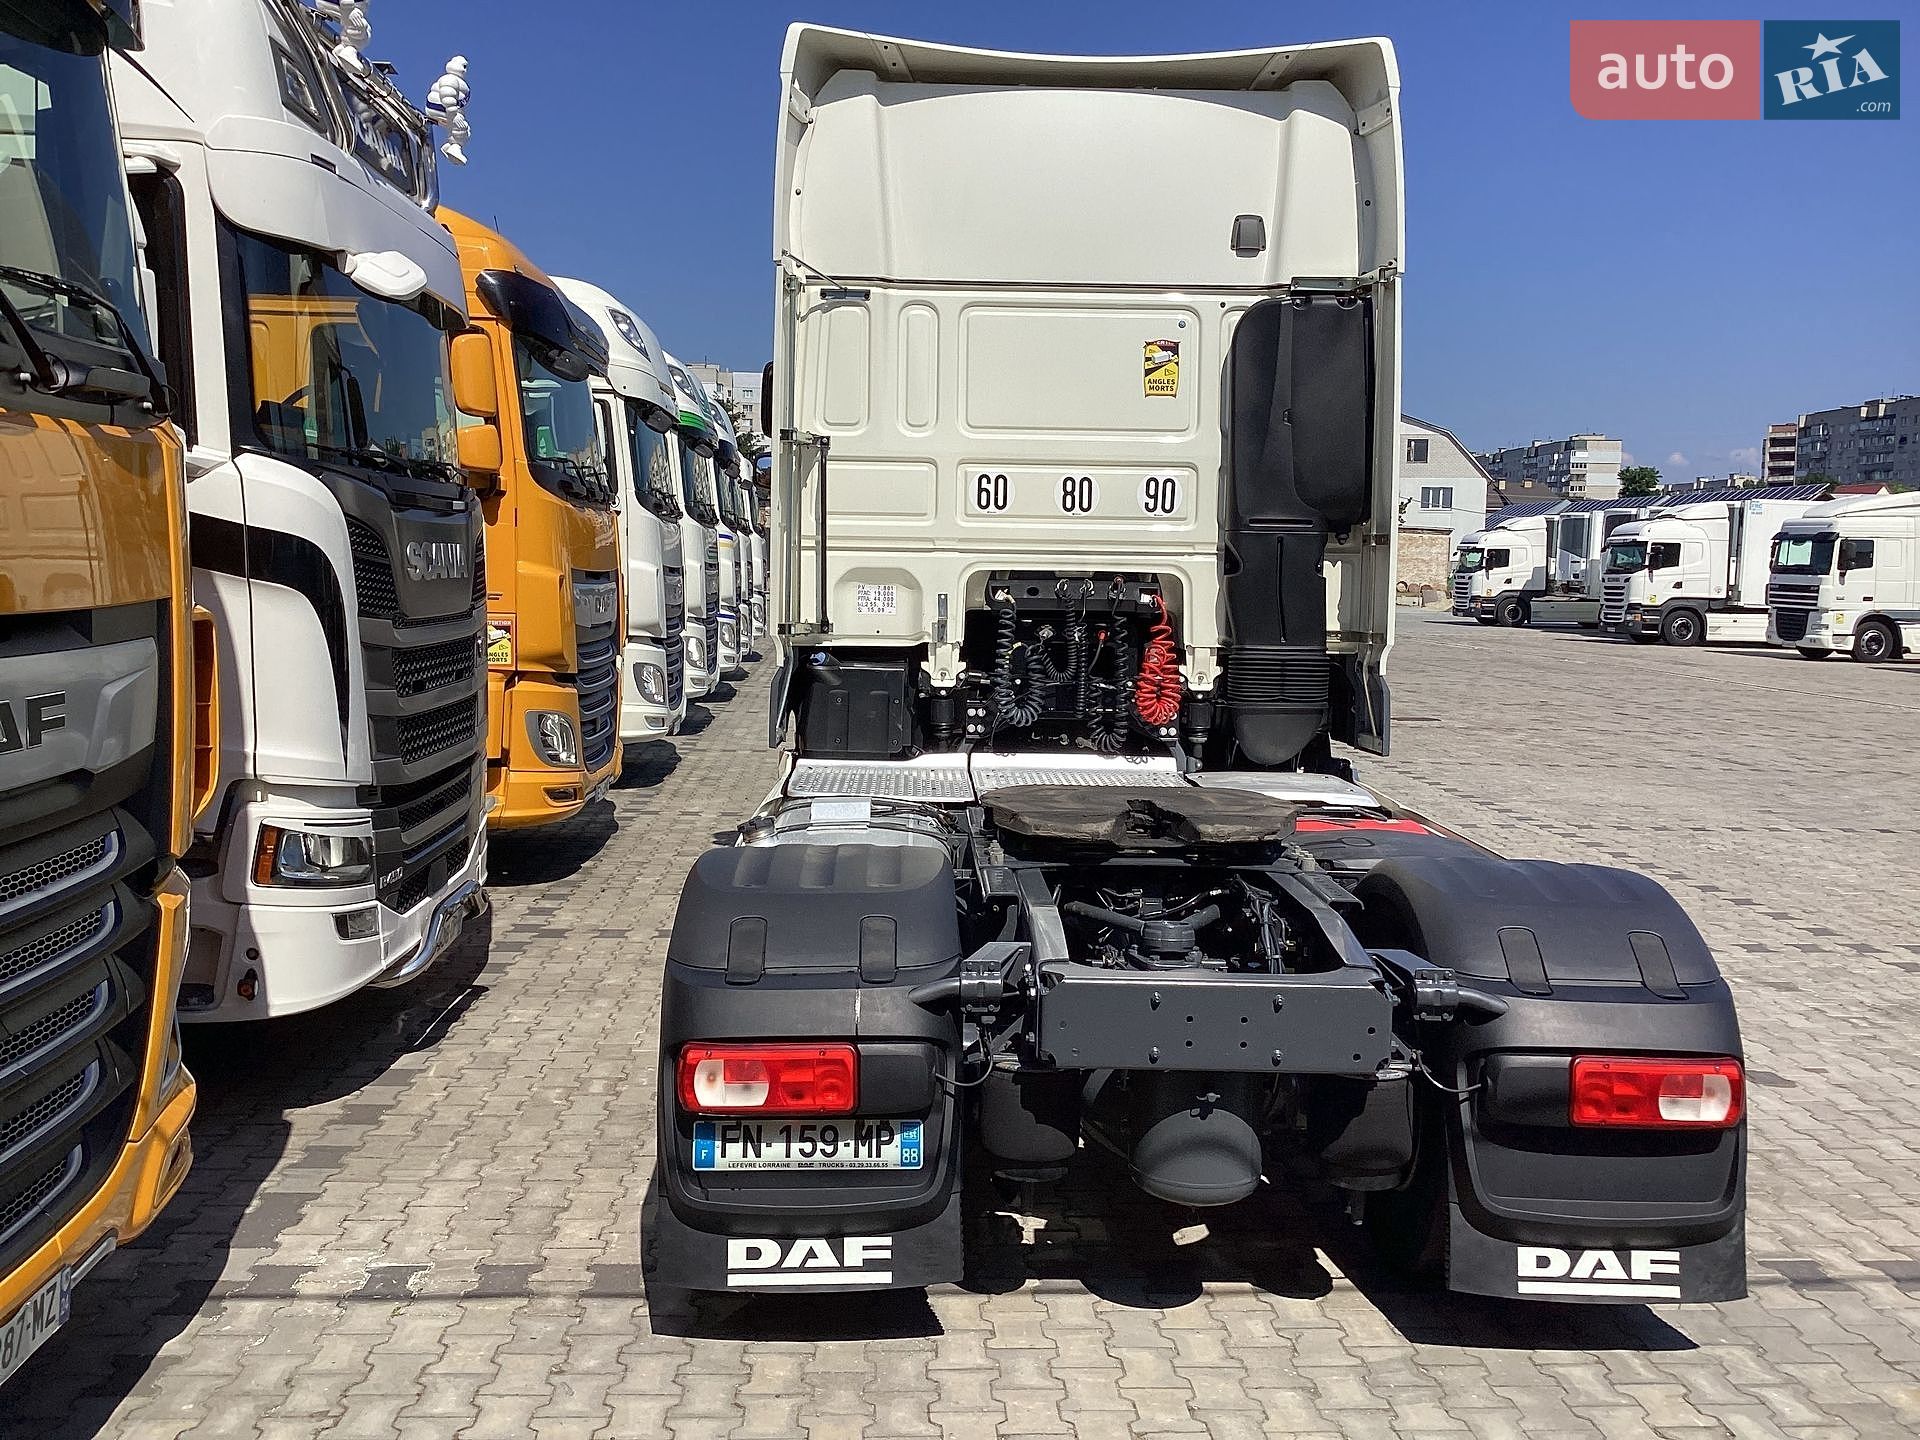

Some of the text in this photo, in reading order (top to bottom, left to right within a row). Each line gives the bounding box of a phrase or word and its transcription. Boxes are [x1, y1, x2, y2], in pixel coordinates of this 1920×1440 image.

[977, 474, 1008, 510] 60
[1062, 476, 1093, 513] 80
[1144, 477, 1176, 514] 90
[406, 541, 469, 580] SCANIA
[701, 1150, 708, 1160] F
[720, 1122, 895, 1159] FN-159-MP
[902, 1149, 918, 1162] 88
[727, 1236, 893, 1270] DAF
[1517, 1246, 1681, 1281] DAF
